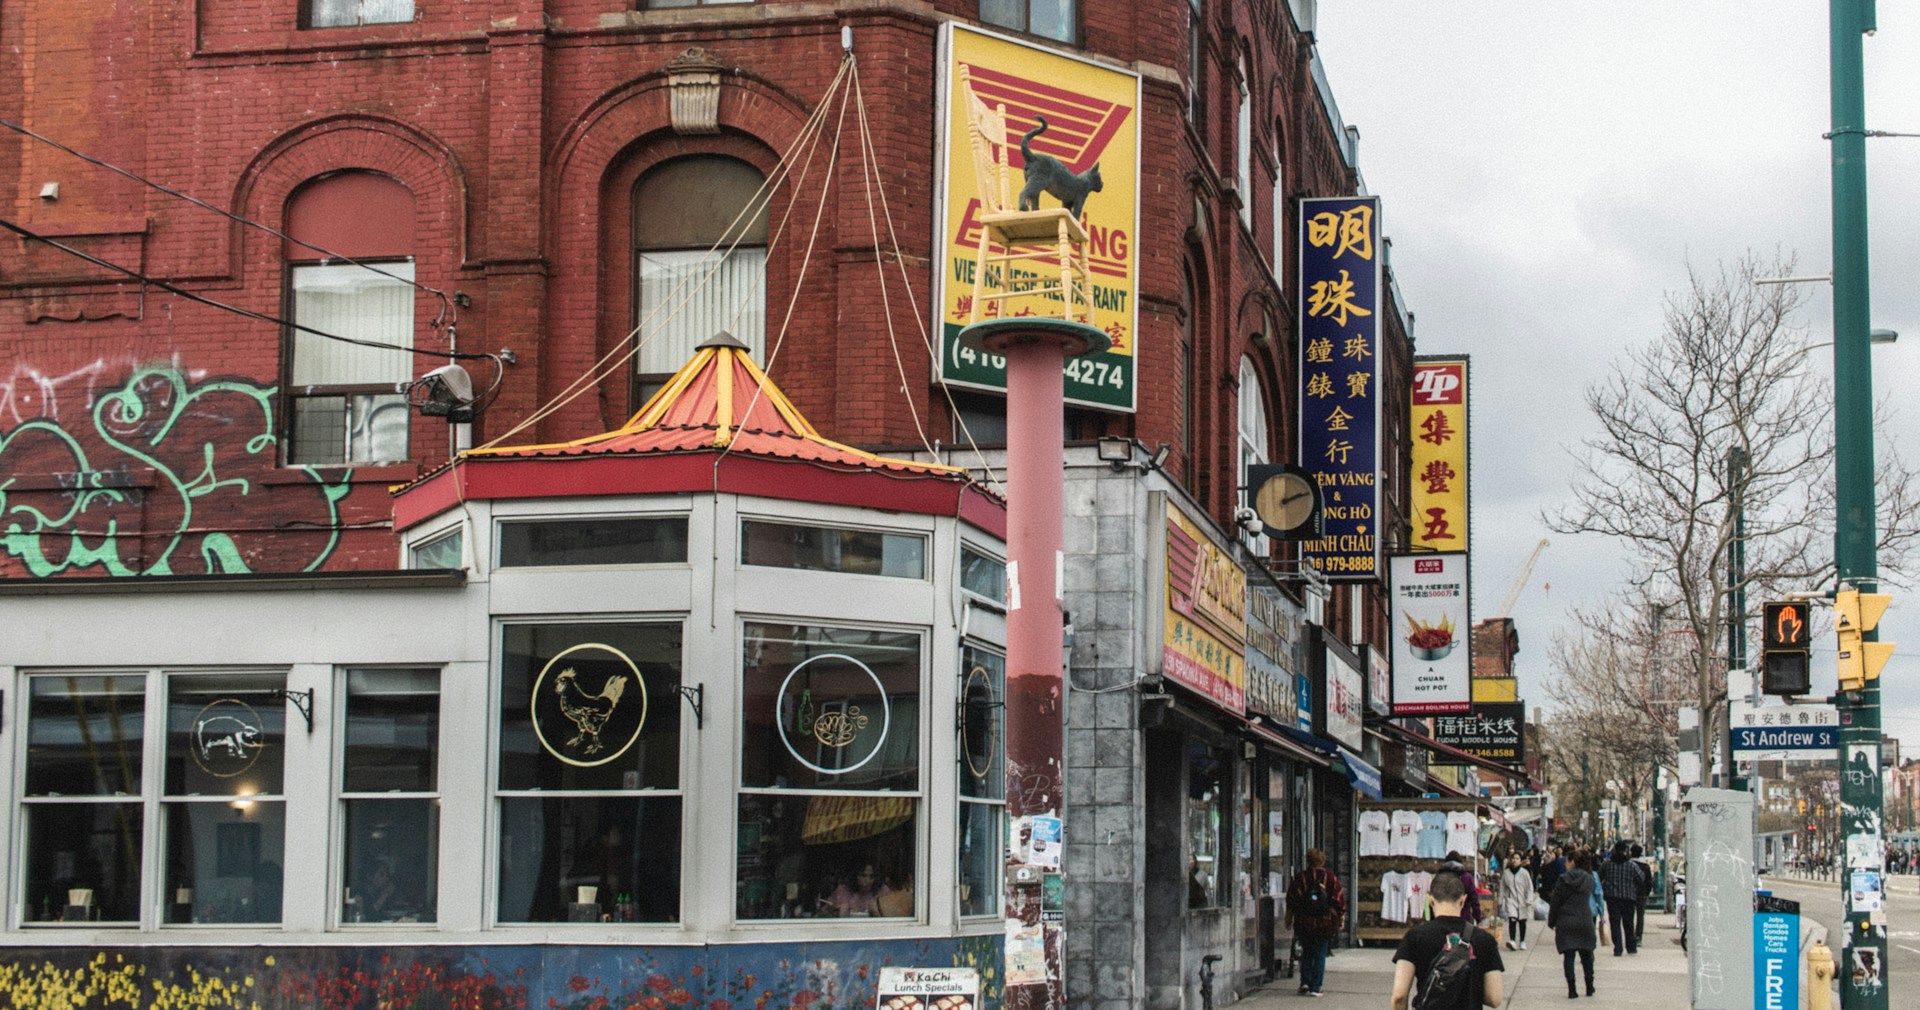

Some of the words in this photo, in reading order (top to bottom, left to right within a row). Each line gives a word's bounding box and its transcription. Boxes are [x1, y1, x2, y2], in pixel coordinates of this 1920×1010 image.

[1307, 205, 1373, 327] 明珠
[954, 257, 1038, 295] VIENAESE
[1043, 275, 1127, 312] RESTARANT
[1325, 405, 1354, 465] 金行
[1333, 491, 1342, 501] &
[1303, 535, 1337, 552] MINH
[1326, 556, 1374, 571] 979-8888
[1741, 731, 1756, 746] St
[1758, 730, 1814, 746] Andrew
[1820, 733, 1831, 745] St
[894, 983, 922, 992] Lunch
[925, 983, 963, 993] Specials
